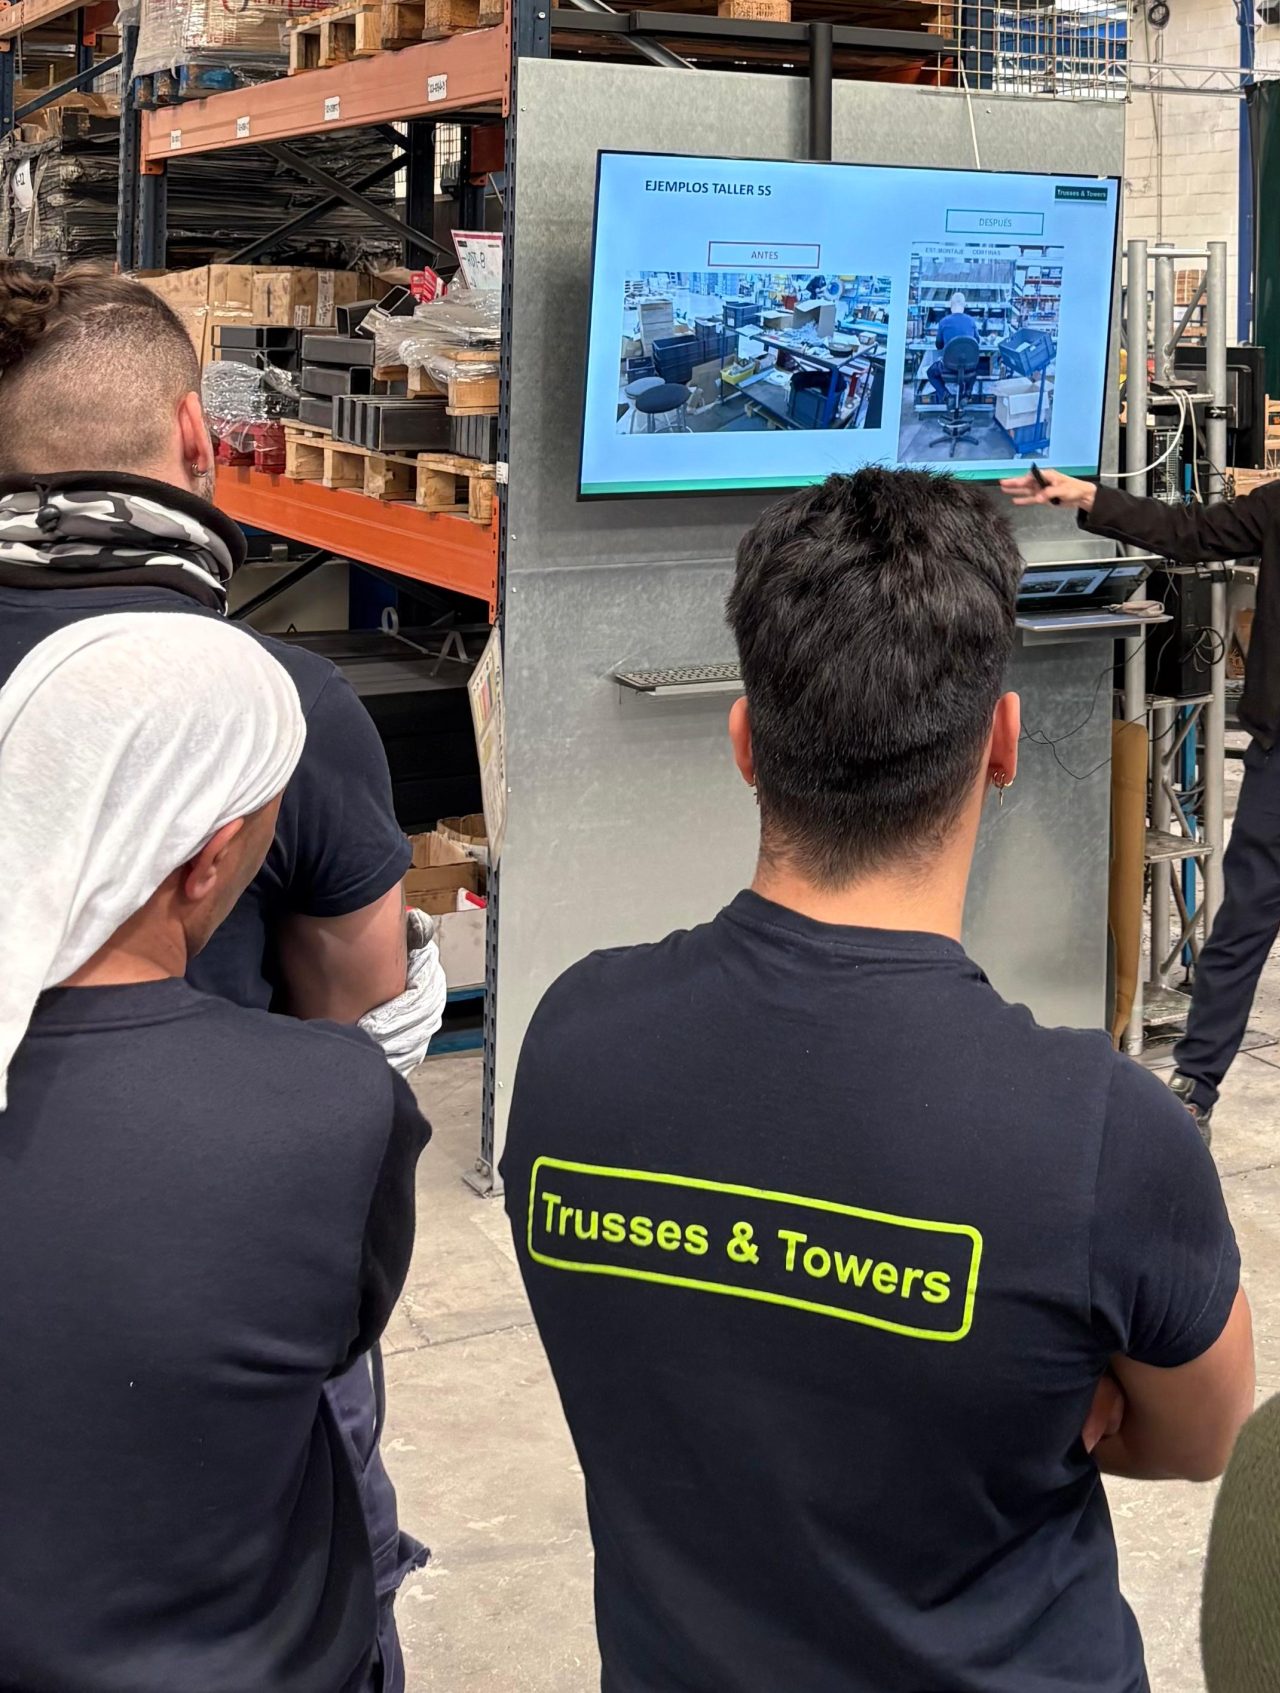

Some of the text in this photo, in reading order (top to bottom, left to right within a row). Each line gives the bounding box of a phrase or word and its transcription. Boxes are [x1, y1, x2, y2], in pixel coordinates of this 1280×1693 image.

[645, 180, 772, 196] EJEMPLOS TALLER 5S
[979, 216, 1012, 228] DESPUÉS
[750, 250, 779, 260] ANTES
[542, 1192, 951, 1304] Trusses & Towers
